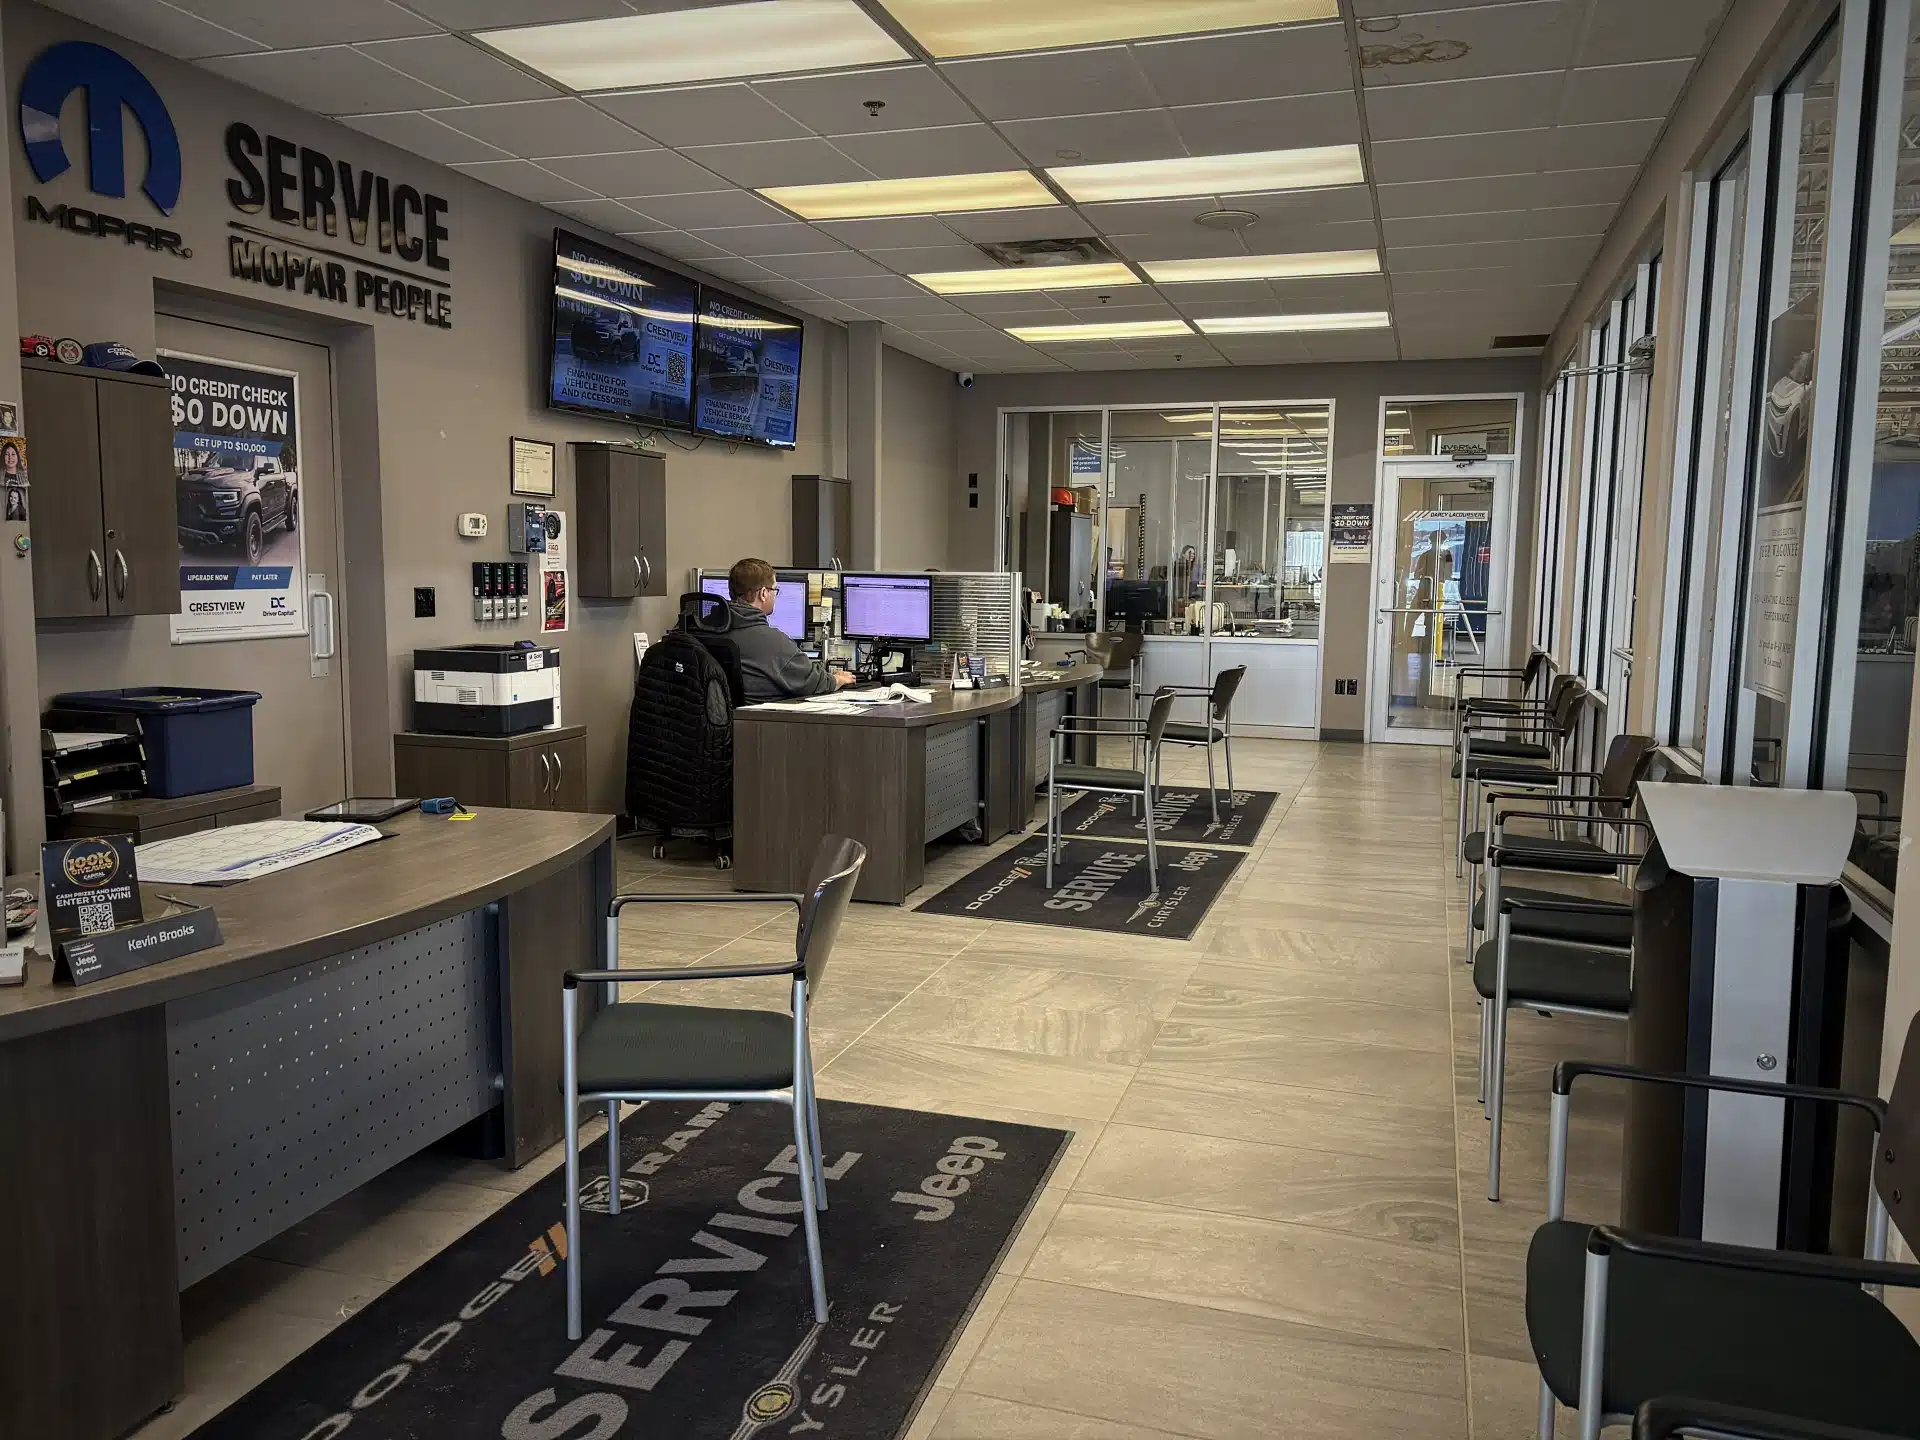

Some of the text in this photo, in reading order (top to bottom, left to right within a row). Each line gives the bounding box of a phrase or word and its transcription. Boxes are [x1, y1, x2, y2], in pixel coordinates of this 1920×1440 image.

[226, 121, 452, 272] SERVICE
[27, 195, 183, 255] MOPAR
[229, 236, 452, 329] MOPAR PEOPLE
[710, 300, 720, 312] NO
[721, 305, 744, 320] CREDIT
[646, 322, 689, 343] CRESTVIEW
[764, 357, 796, 375] CRESTVIEW
[564, 376, 629, 398] VEHICLE REPAIRS
[567, 367, 627, 387] FINANCING FOR
[190, 377, 241, 400] CREDIT
[242, 385, 288, 407] CHECK
[561, 387, 632, 408] AND ACCESSORIES
[704, 407, 728, 419] VEHICLE
[705, 398, 737, 412] FINANCING
[212, 401, 288, 435] DOWN
[702, 415, 715, 424] AND
[194, 437, 267, 453] GET UP TO $10,000
[1346, 519, 1370, 527] DOWN
[189, 601, 245, 612] CRESTVIEW
[1135, 792, 1199, 831] SERVICE
[68, 850, 112, 871] 100K
[71, 861, 114, 876] GIVEAWAY
[1168, 851, 1218, 872] Jeep
[73, 890, 96, 898] PRIZES
[110, 885, 131, 893] MORE!
[965, 868, 1023, 910] DODGE
[1044, 852, 1146, 911] SERVICE
[56, 891, 132, 907] ENTER TO WIN!
[1147, 886, 1191, 928] CHRYSLER
[127, 925, 195, 951] Kevin Brooks
[76, 955, 97, 967] Jeep
[626, 1101, 731, 1175] RAM
[891, 1135, 1006, 1221] Jeep
[500, 1144, 863, 1440] SERVICE
[788, 1301, 903, 1435] YSLER
